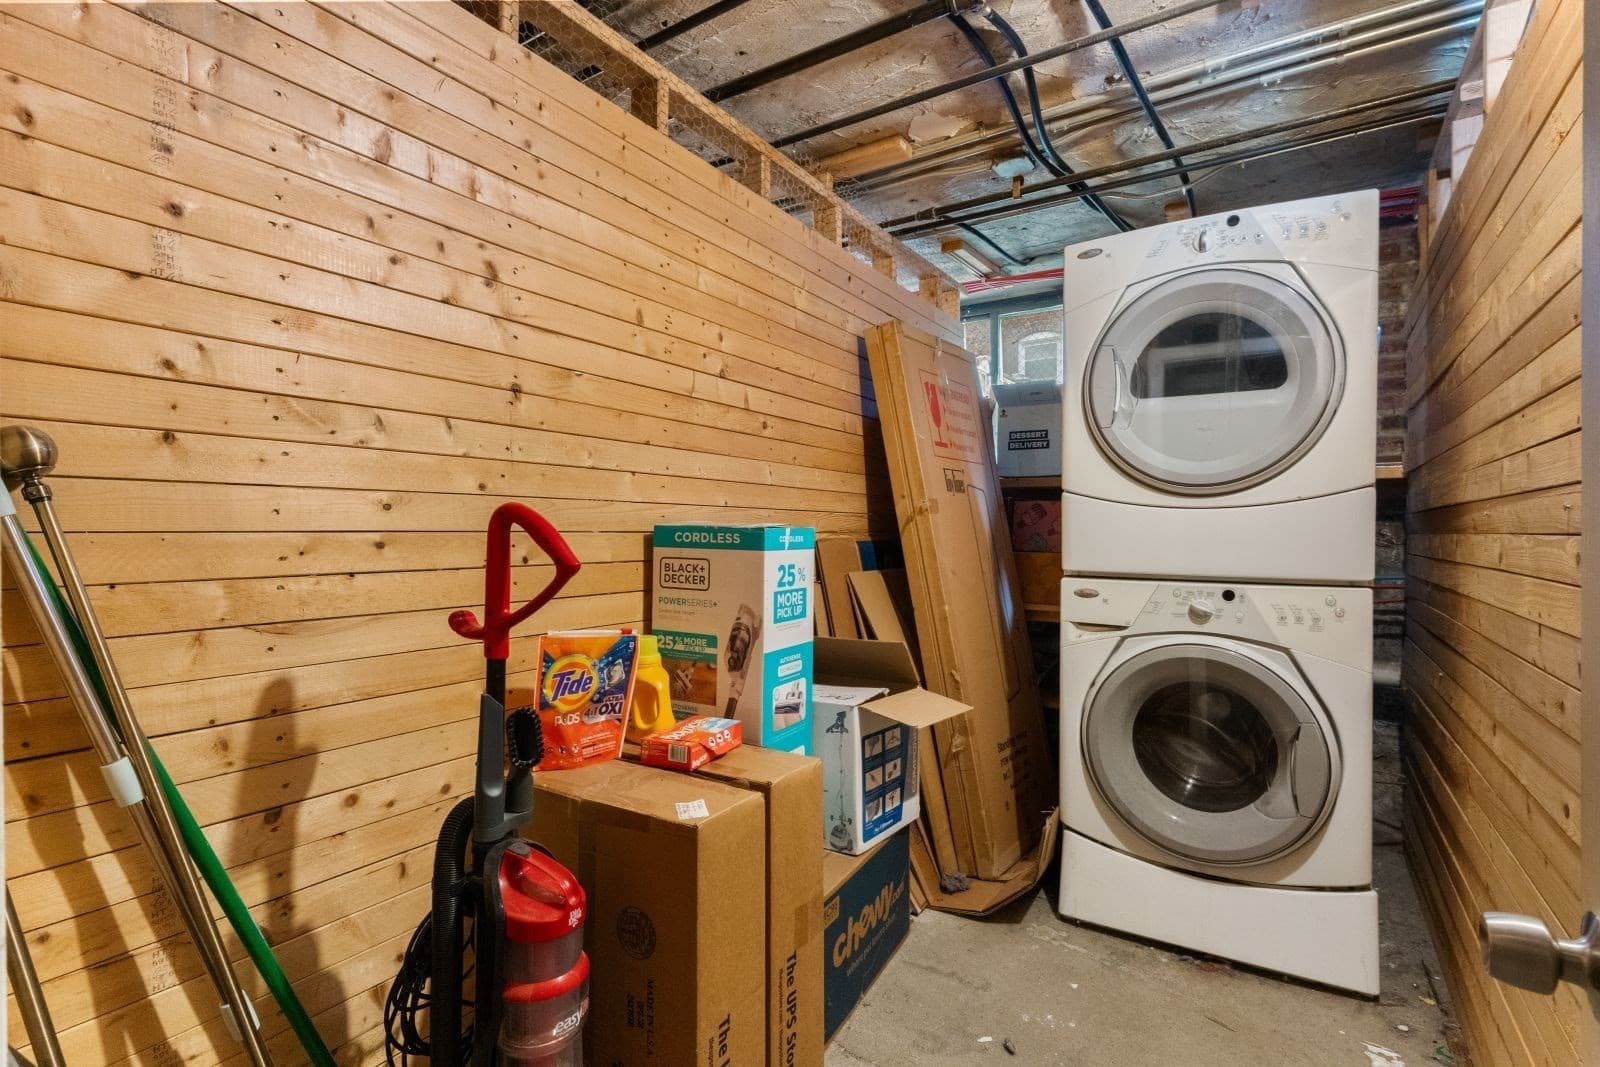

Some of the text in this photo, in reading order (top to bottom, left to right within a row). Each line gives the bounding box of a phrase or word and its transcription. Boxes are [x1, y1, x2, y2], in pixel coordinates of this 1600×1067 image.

[1010, 431, 1047, 439] DESSERT
[1009, 441, 1048, 449] DELIVERY
[674, 531, 741, 544] CORDLESS
[779, 535, 804, 543] CODLESS
[664, 562, 706, 574] BLACK+
[663, 573, 706, 585] DECKER
[777, 591, 804, 606] MORE
[777, 606, 803, 619] PICK UP
[683, 636, 707, 647] MORE
[551, 668, 593, 702] Tide
[599, 701, 624, 716] OXI
[554, 711, 581, 726] PODS
[786, 950, 797, 989] The
[786, 989, 798, 1029] UPS
[718, 1013, 731, 1059] The
